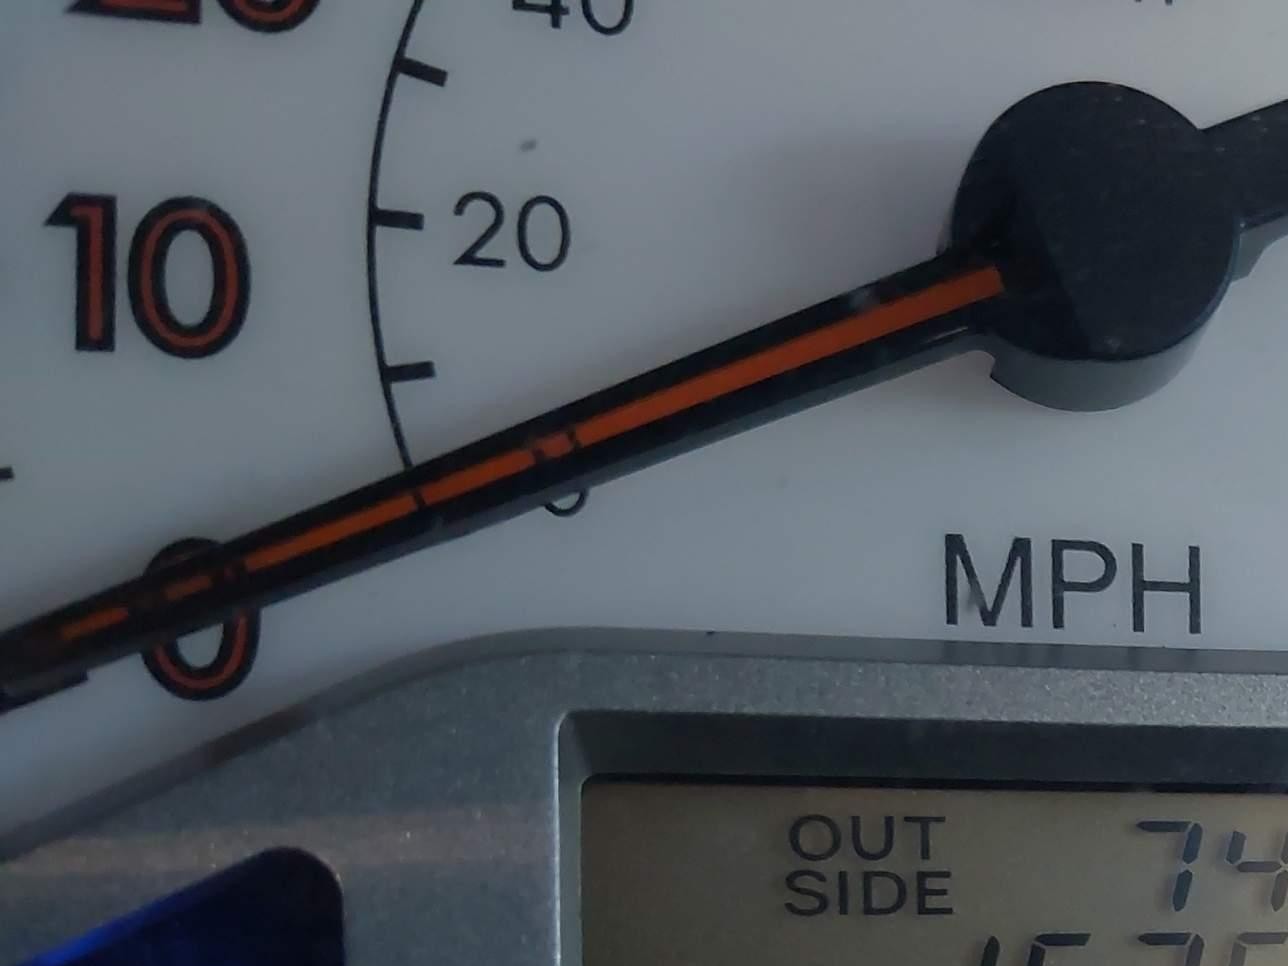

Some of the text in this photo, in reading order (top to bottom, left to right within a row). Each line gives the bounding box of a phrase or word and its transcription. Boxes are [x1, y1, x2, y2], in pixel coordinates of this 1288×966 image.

[453, 191, 571, 272] 20
[44, 192, 251, 359] 10
[944, 533, 1202, 635] MPH
[787, 814, 948, 863] OUT
[784, 868, 954, 917] SIDE
